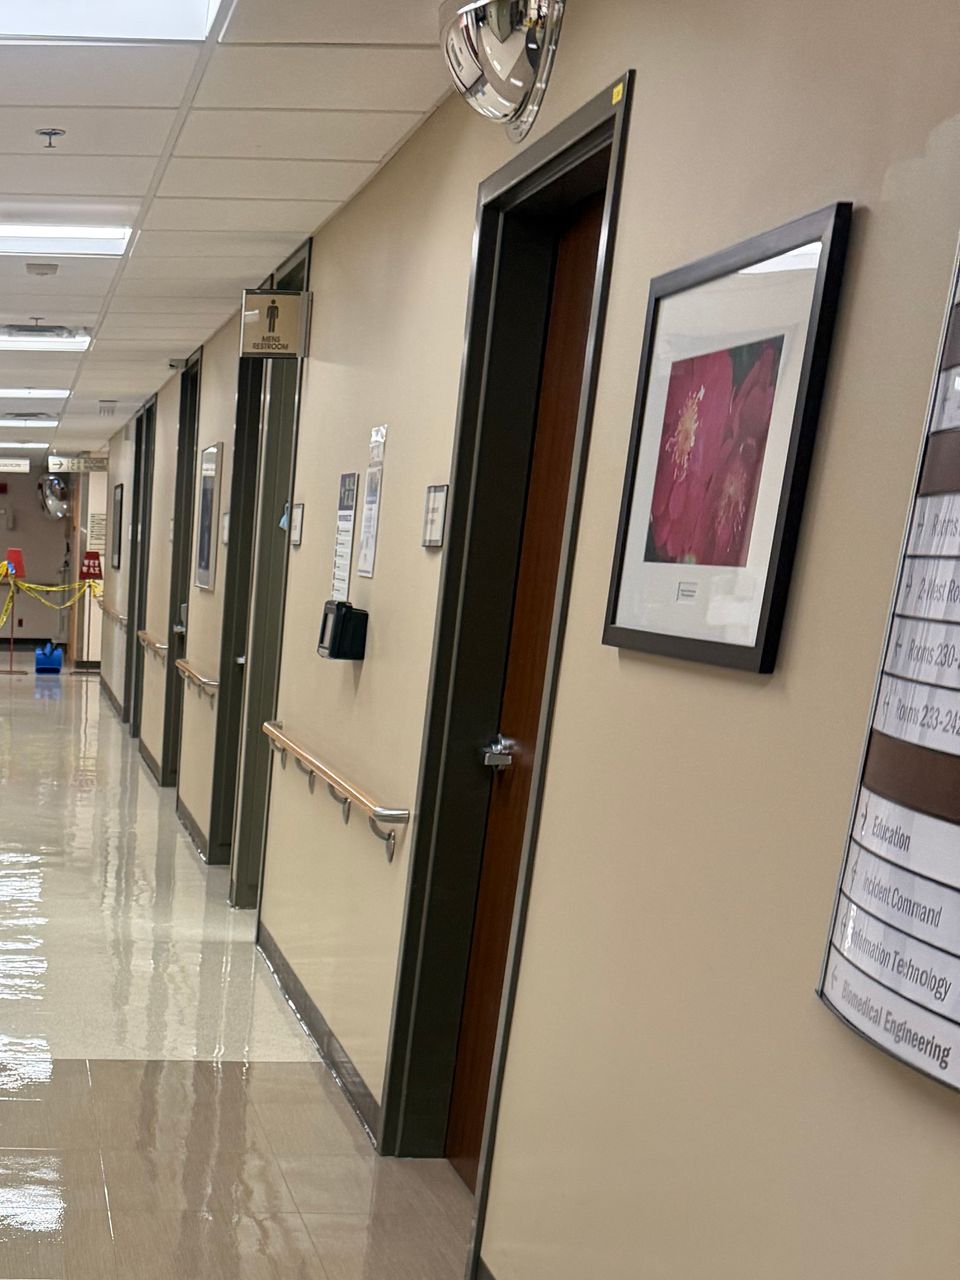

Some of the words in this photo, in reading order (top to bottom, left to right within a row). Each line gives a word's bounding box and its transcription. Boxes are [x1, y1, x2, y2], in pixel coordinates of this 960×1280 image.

[252, 342, 289, 350] RESTROOM
[262, 335, 280, 343] MENS
[82, 566, 100, 574] WAX
[83, 559, 99, 567] WET
[947, 578, 960, 604] Ro
[908, 639, 934, 665] Rooms
[935, 643, 960, 670] 230-
[872, 815, 911, 853] Education
[863, 873, 891, 906] Incident
[891, 887, 943, 928] Command
[852, 927, 891, 969] Information
[891, 950, 952, 1002] Technology
[842, 979, 883, 1027] Biomedical
[883, 1011, 952, 1070] Engineering
